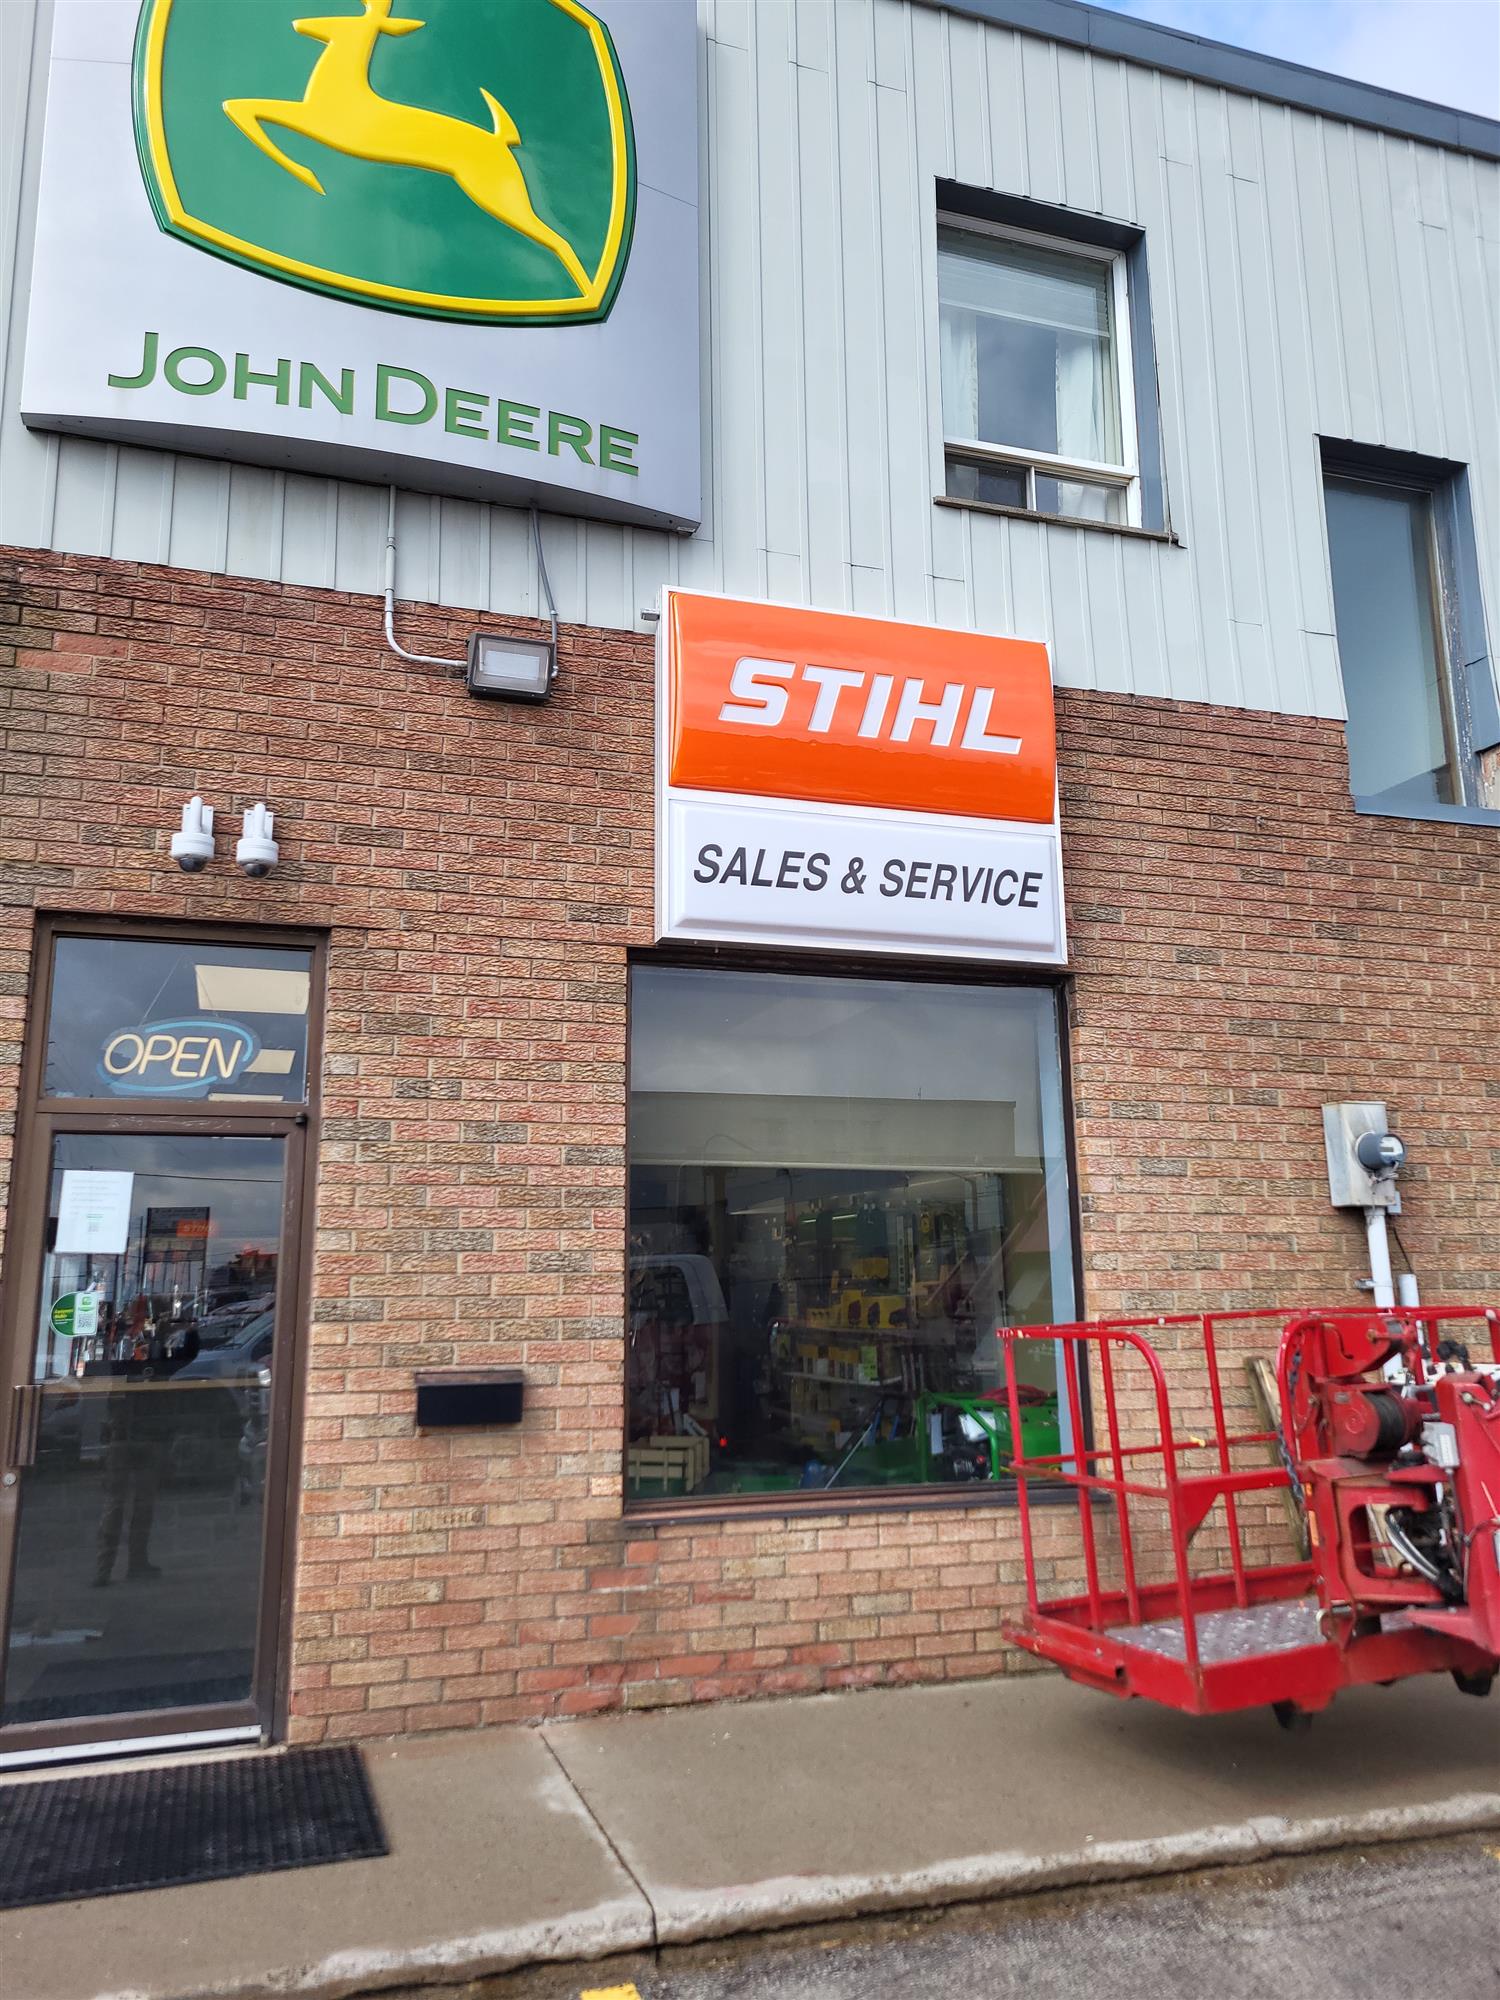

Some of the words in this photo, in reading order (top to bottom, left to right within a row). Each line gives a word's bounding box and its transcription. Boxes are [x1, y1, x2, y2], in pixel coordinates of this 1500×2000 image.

[108, 332, 355, 415] JOHN
[375, 363, 639, 476] DEERE
[718, 656, 1023, 755] STIHL
[693, 843, 831, 891] SALES
[840, 856, 867, 895] &
[879, 858, 1043, 909] SERVICE
[104, 1033, 243, 1079] OPEN
